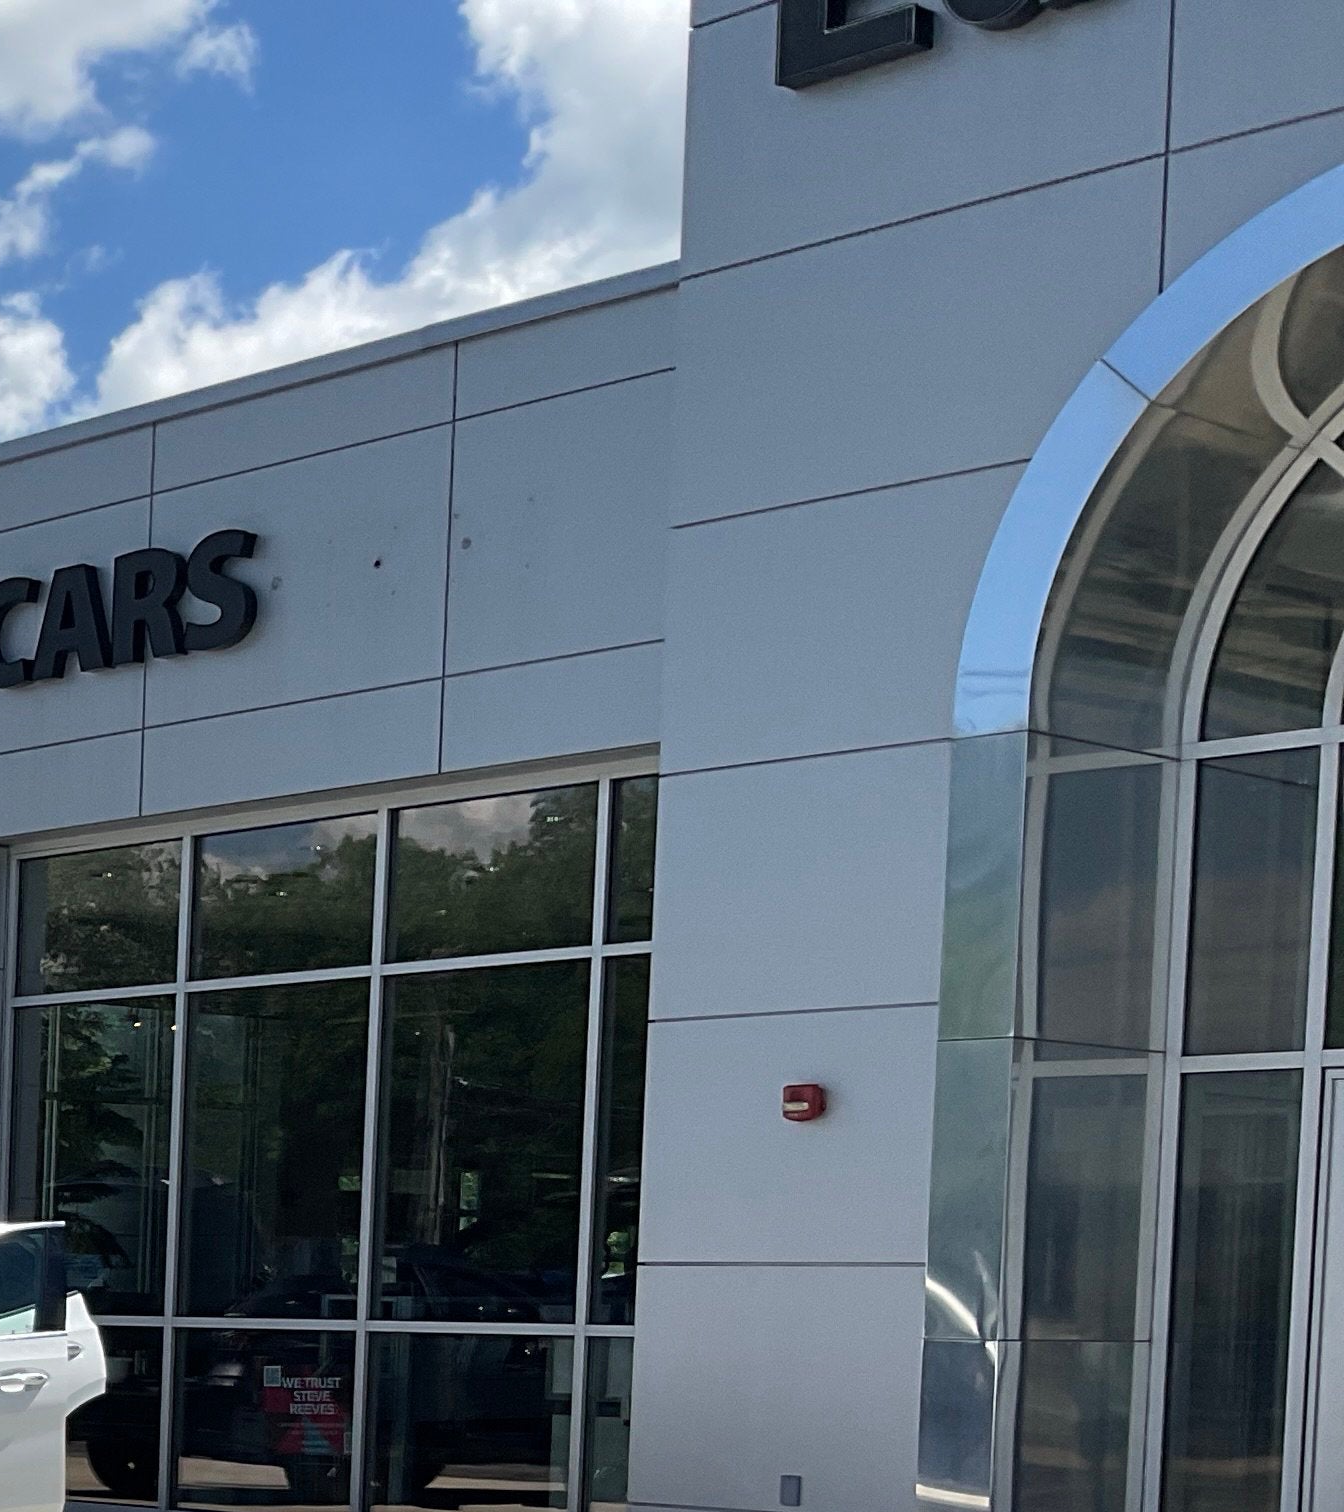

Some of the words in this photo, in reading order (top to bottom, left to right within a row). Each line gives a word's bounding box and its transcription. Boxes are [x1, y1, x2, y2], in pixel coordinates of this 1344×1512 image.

[281, 1376, 302, 1388] WE
[303, 1376, 342, 1388] TRUST
[293, 1390, 331, 1402] STEVE
[289, 1403, 335, 1415] REEVES
